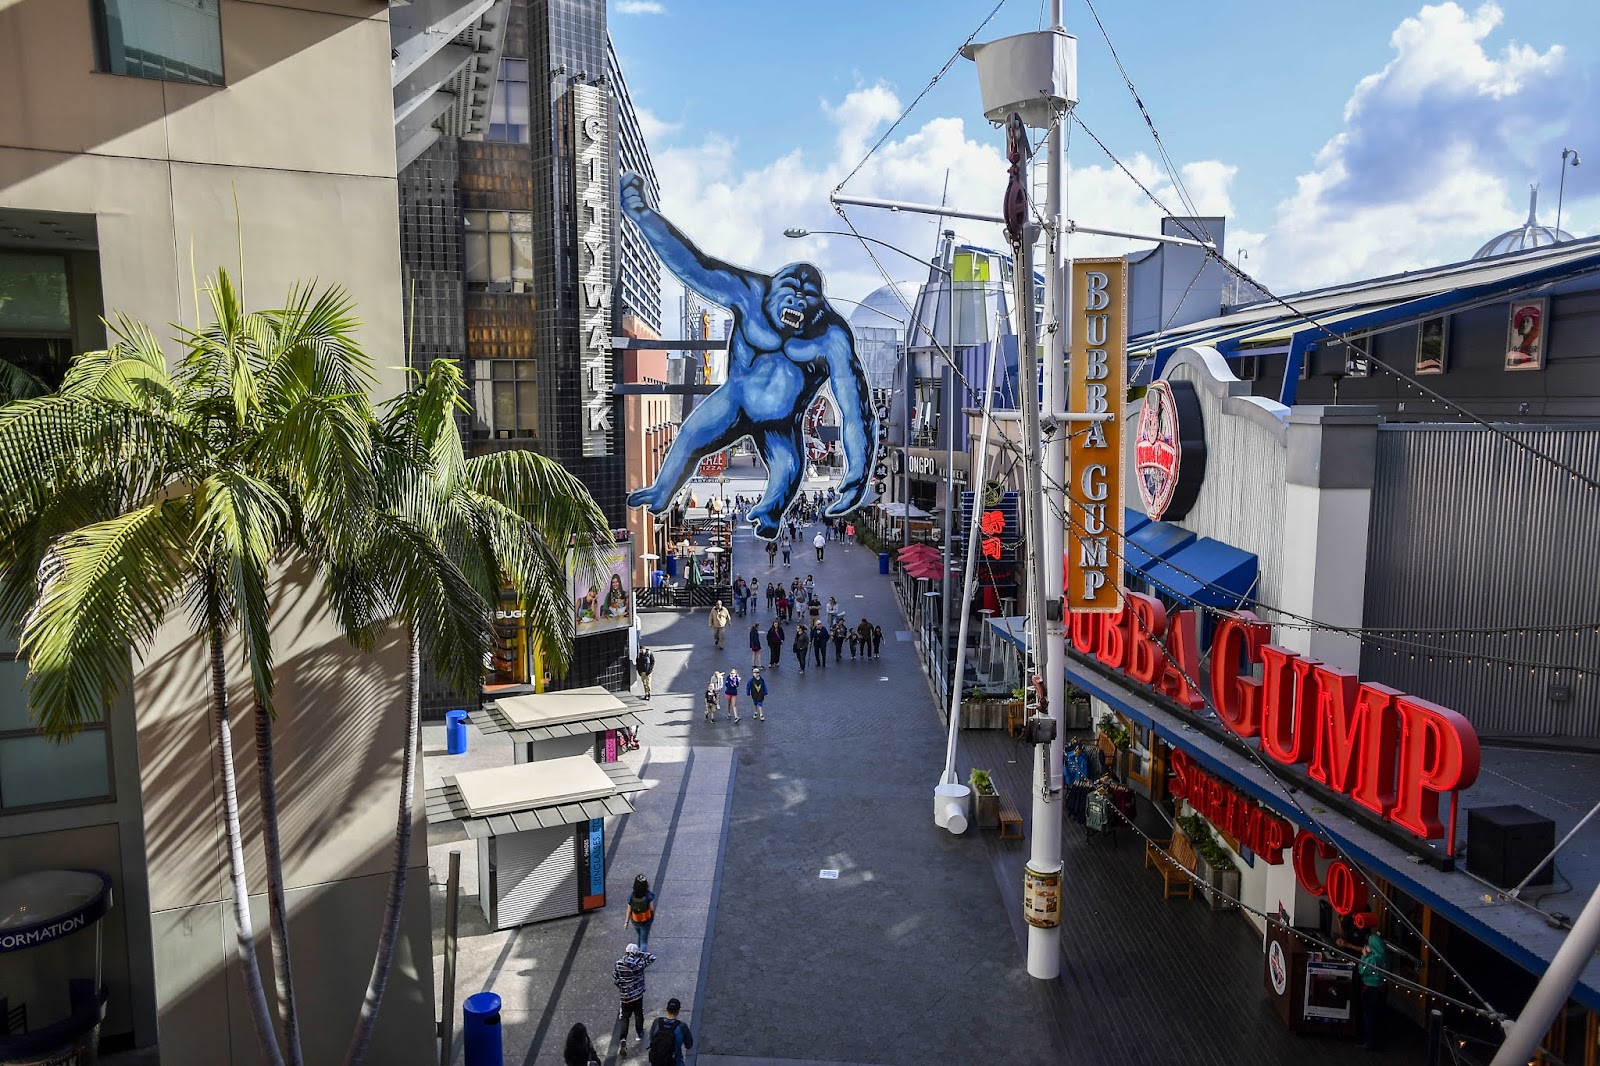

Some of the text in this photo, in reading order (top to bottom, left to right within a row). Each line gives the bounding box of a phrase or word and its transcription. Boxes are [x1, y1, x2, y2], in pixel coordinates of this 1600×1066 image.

[584, 116, 613, 430] CITYWALK
[908, 455, 935, 475] ONGPO
[1079, 271, 1109, 599] BUBBA GUMP
[1064, 575, 1480, 840] UBBA GUMP
[1168, 748, 1295, 865] SHRIMP
[0, 914, 85, 947] ORMATION
